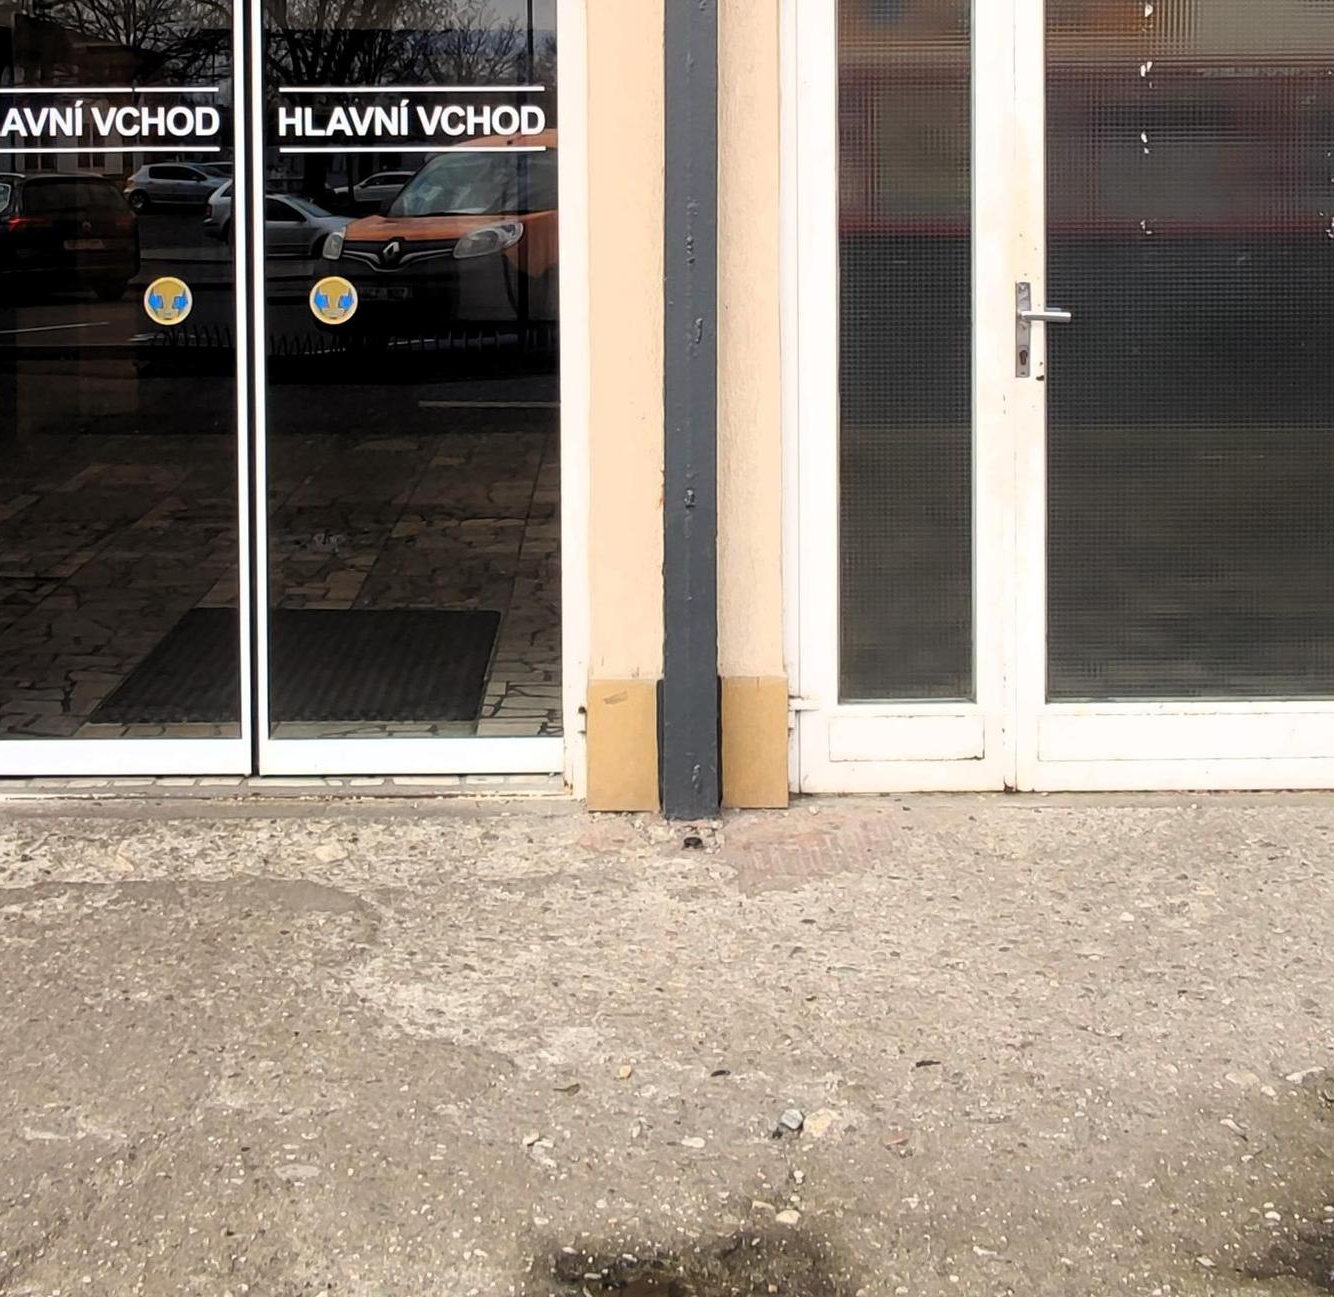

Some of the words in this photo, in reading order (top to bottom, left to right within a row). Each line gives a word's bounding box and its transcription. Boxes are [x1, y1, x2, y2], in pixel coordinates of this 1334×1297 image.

[91, 106, 220, 137] VCHOD
[278, 99, 409, 136] HLAVNÍ
[417, 105, 546, 136] VCHOD
